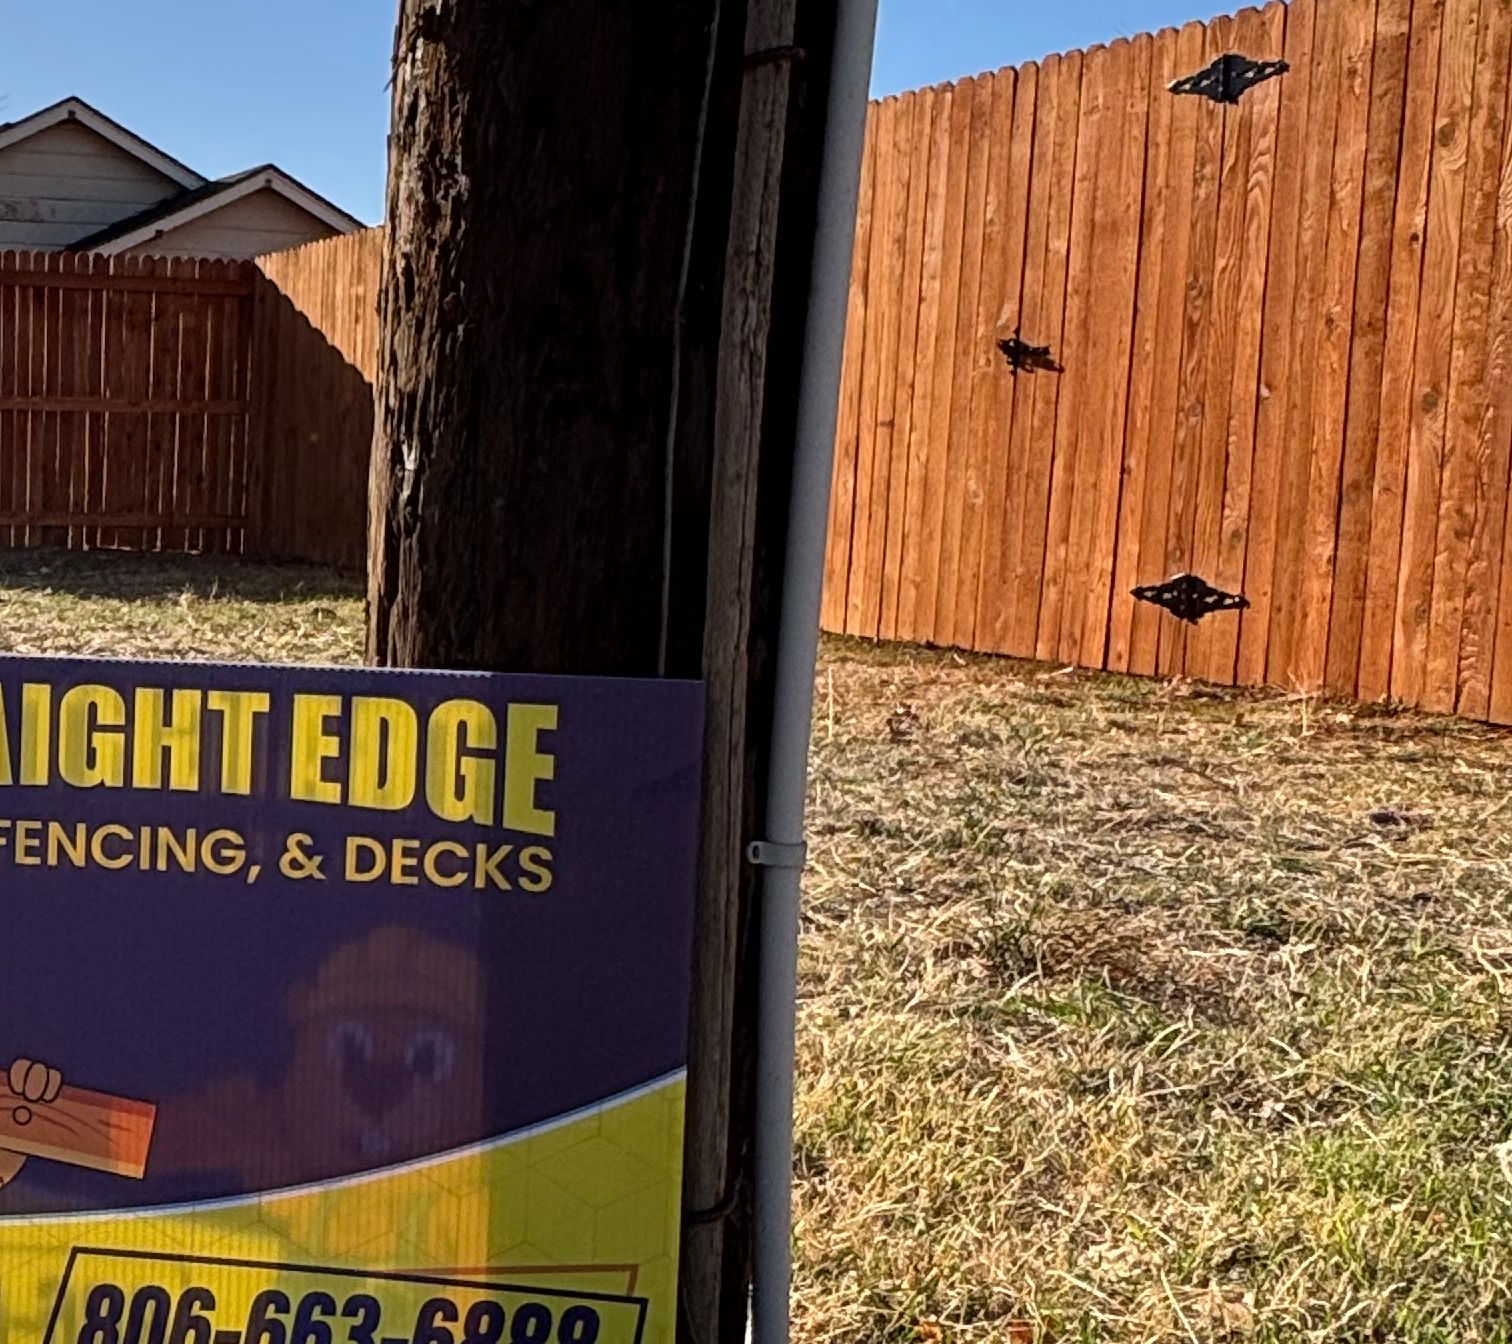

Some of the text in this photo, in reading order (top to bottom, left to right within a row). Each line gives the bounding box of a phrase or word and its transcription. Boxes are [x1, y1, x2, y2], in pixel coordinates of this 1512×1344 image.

[290, 693, 559, 836] EDGE
[278, 833, 326, 881] &
[344, 838, 555, 892] DECKS
